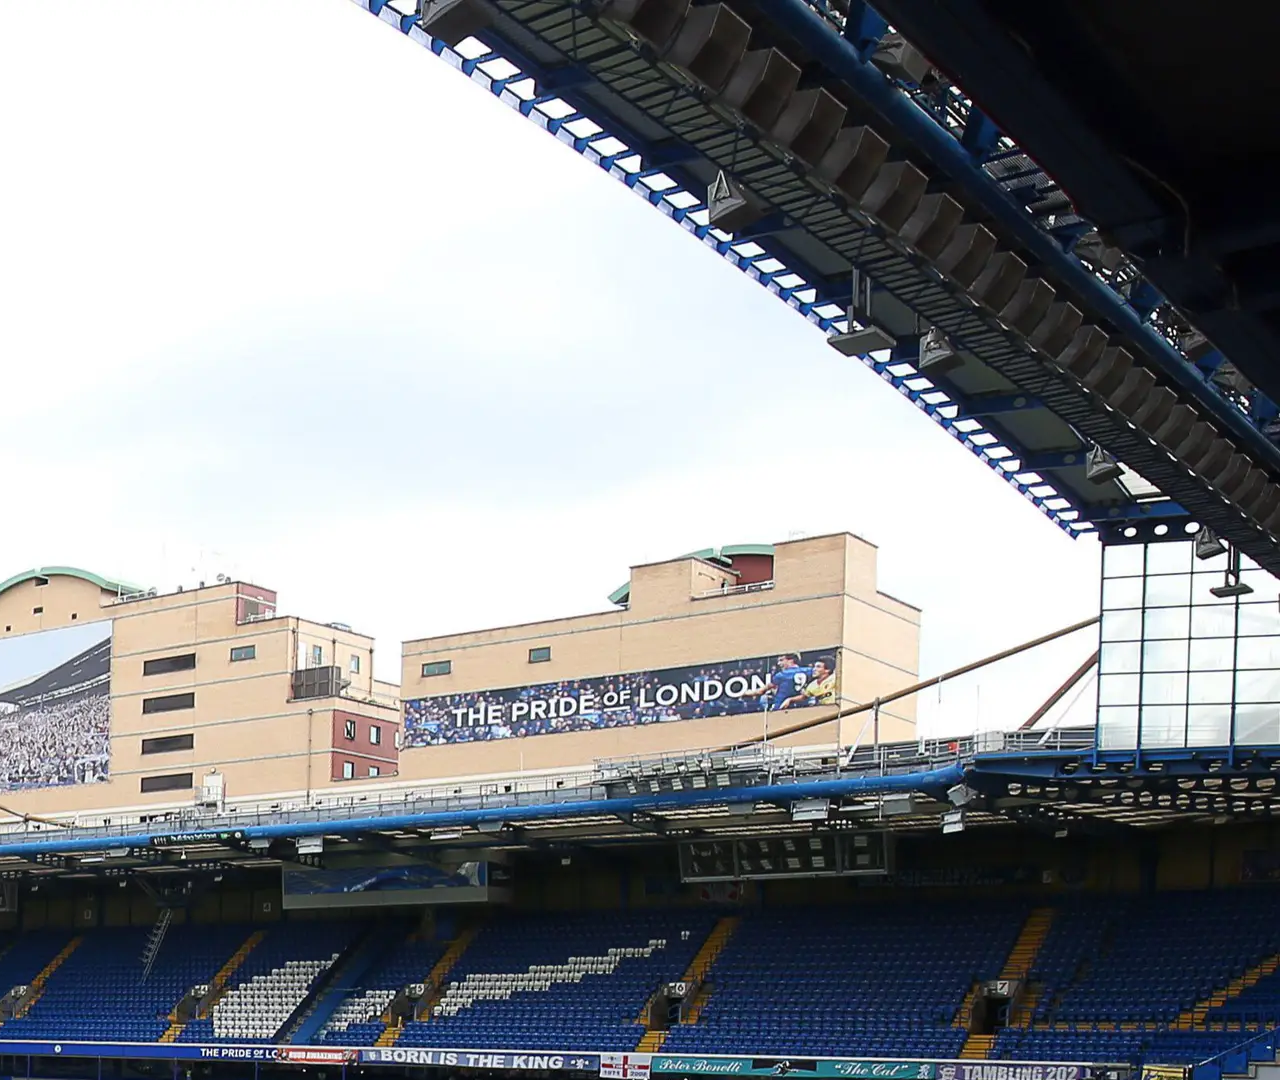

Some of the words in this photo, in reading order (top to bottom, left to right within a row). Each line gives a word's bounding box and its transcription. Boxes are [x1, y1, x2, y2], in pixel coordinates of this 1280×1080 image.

[452, 706, 502, 728] THE
[511, 694, 594, 723] PRIDE
[603, 690, 629, 708] OF
[640, 674, 771, 708] LONDON
[200, 1049, 218, 1057] THE
[221, 1049, 251, 1058] PRIDE
[253, 1049, 264, 1058] OF
[381, 1050, 432, 1064] BORN
[439, 1053, 458, 1065] IS
[466, 1054, 504, 1068] THE
[512, 1056, 563, 1069] KING
[659, 1058, 691, 1071] Peter
[695, 1060, 743, 1073] Bonetti
